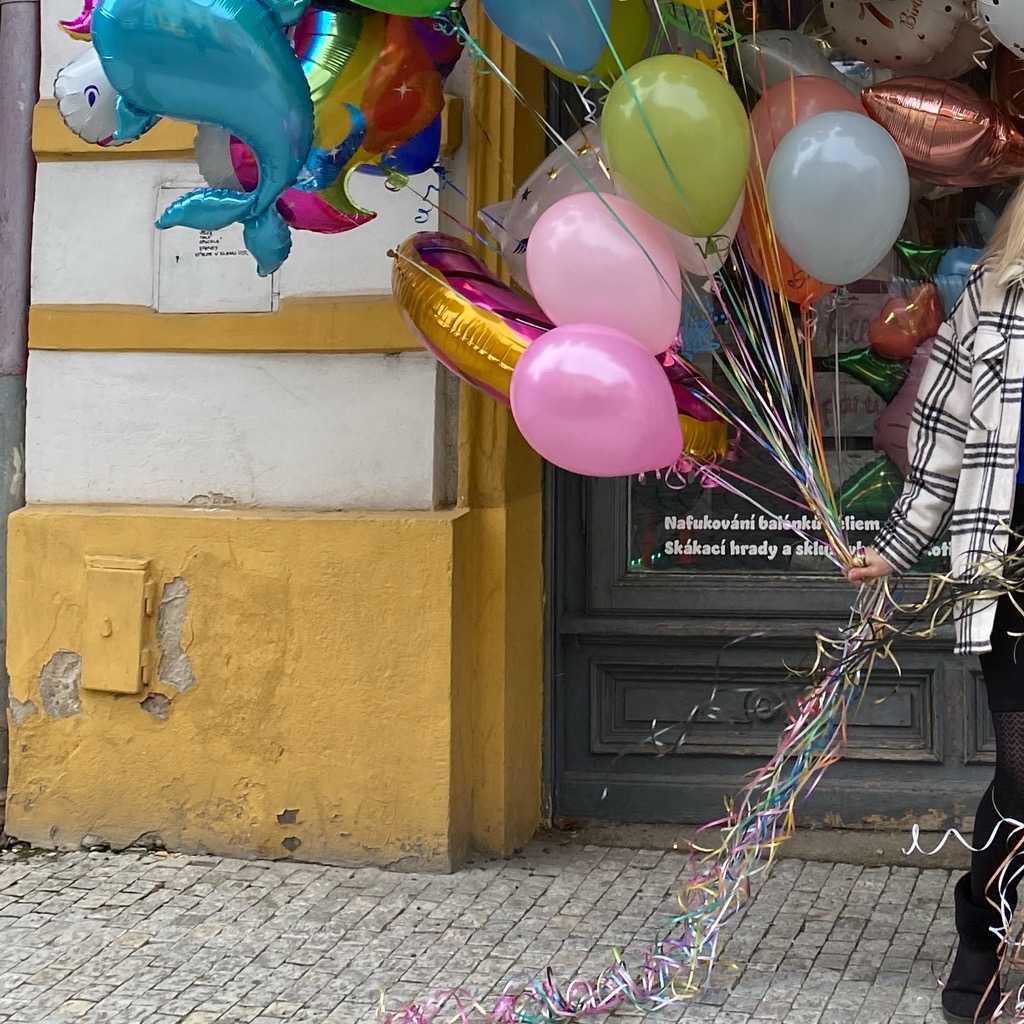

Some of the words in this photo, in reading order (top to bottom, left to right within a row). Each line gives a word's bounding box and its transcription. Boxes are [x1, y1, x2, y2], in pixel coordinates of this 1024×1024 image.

[664, 513, 756, 530] Nafukování
[838, 515, 880, 531] eliem
[664, 538, 726, 556] Skákací
[729, 539, 778, 560] hrady
[781, 544, 792, 556] a
